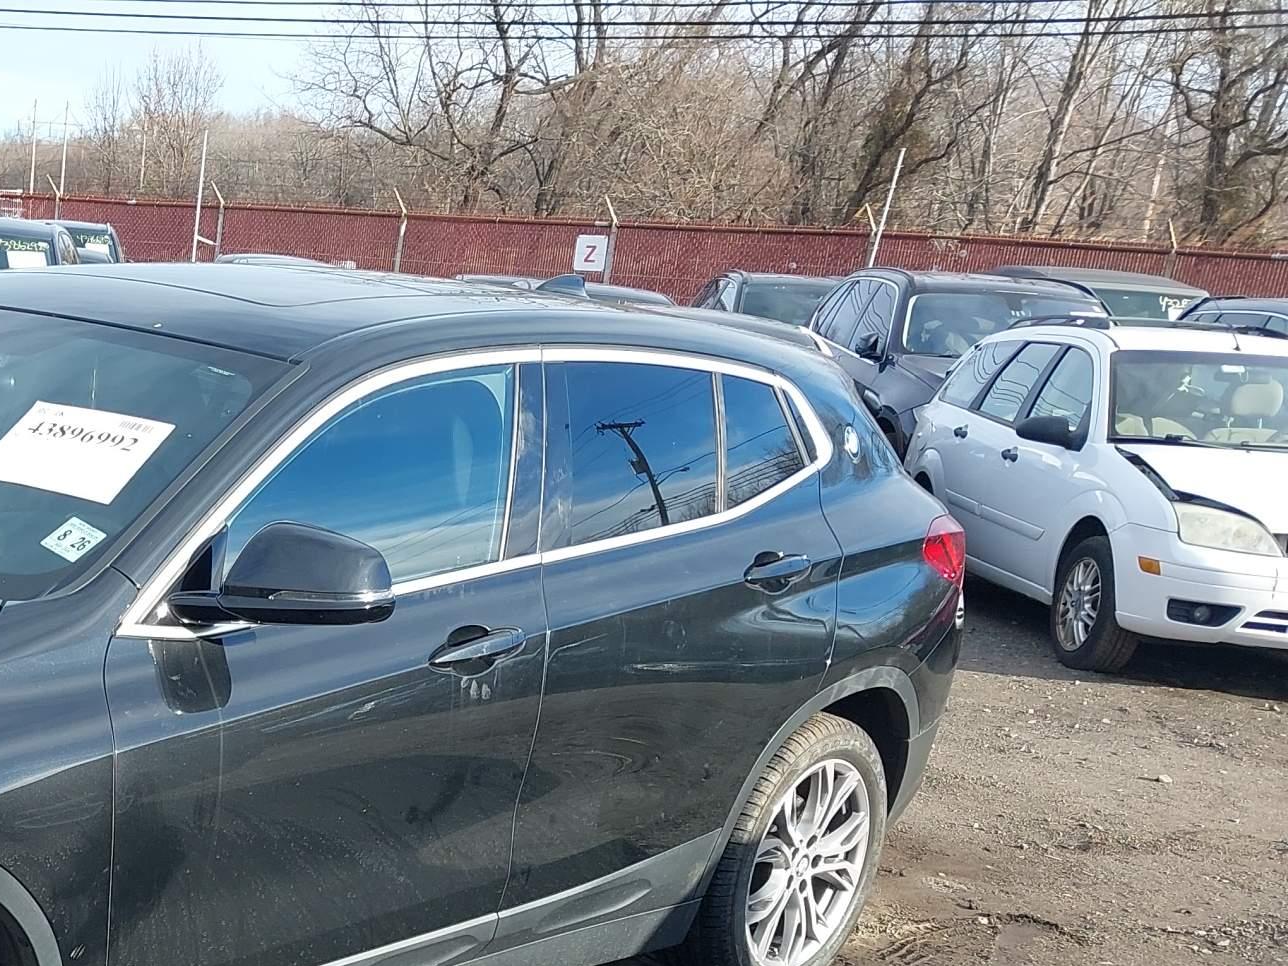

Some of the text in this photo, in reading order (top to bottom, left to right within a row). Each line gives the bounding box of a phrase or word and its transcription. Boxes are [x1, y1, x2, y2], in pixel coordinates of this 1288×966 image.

[584, 245, 597, 263] Z
[28, 421, 139, 452] 43896992
[57, 529, 72, 541] 8
[70, 537, 91, 551] 26
